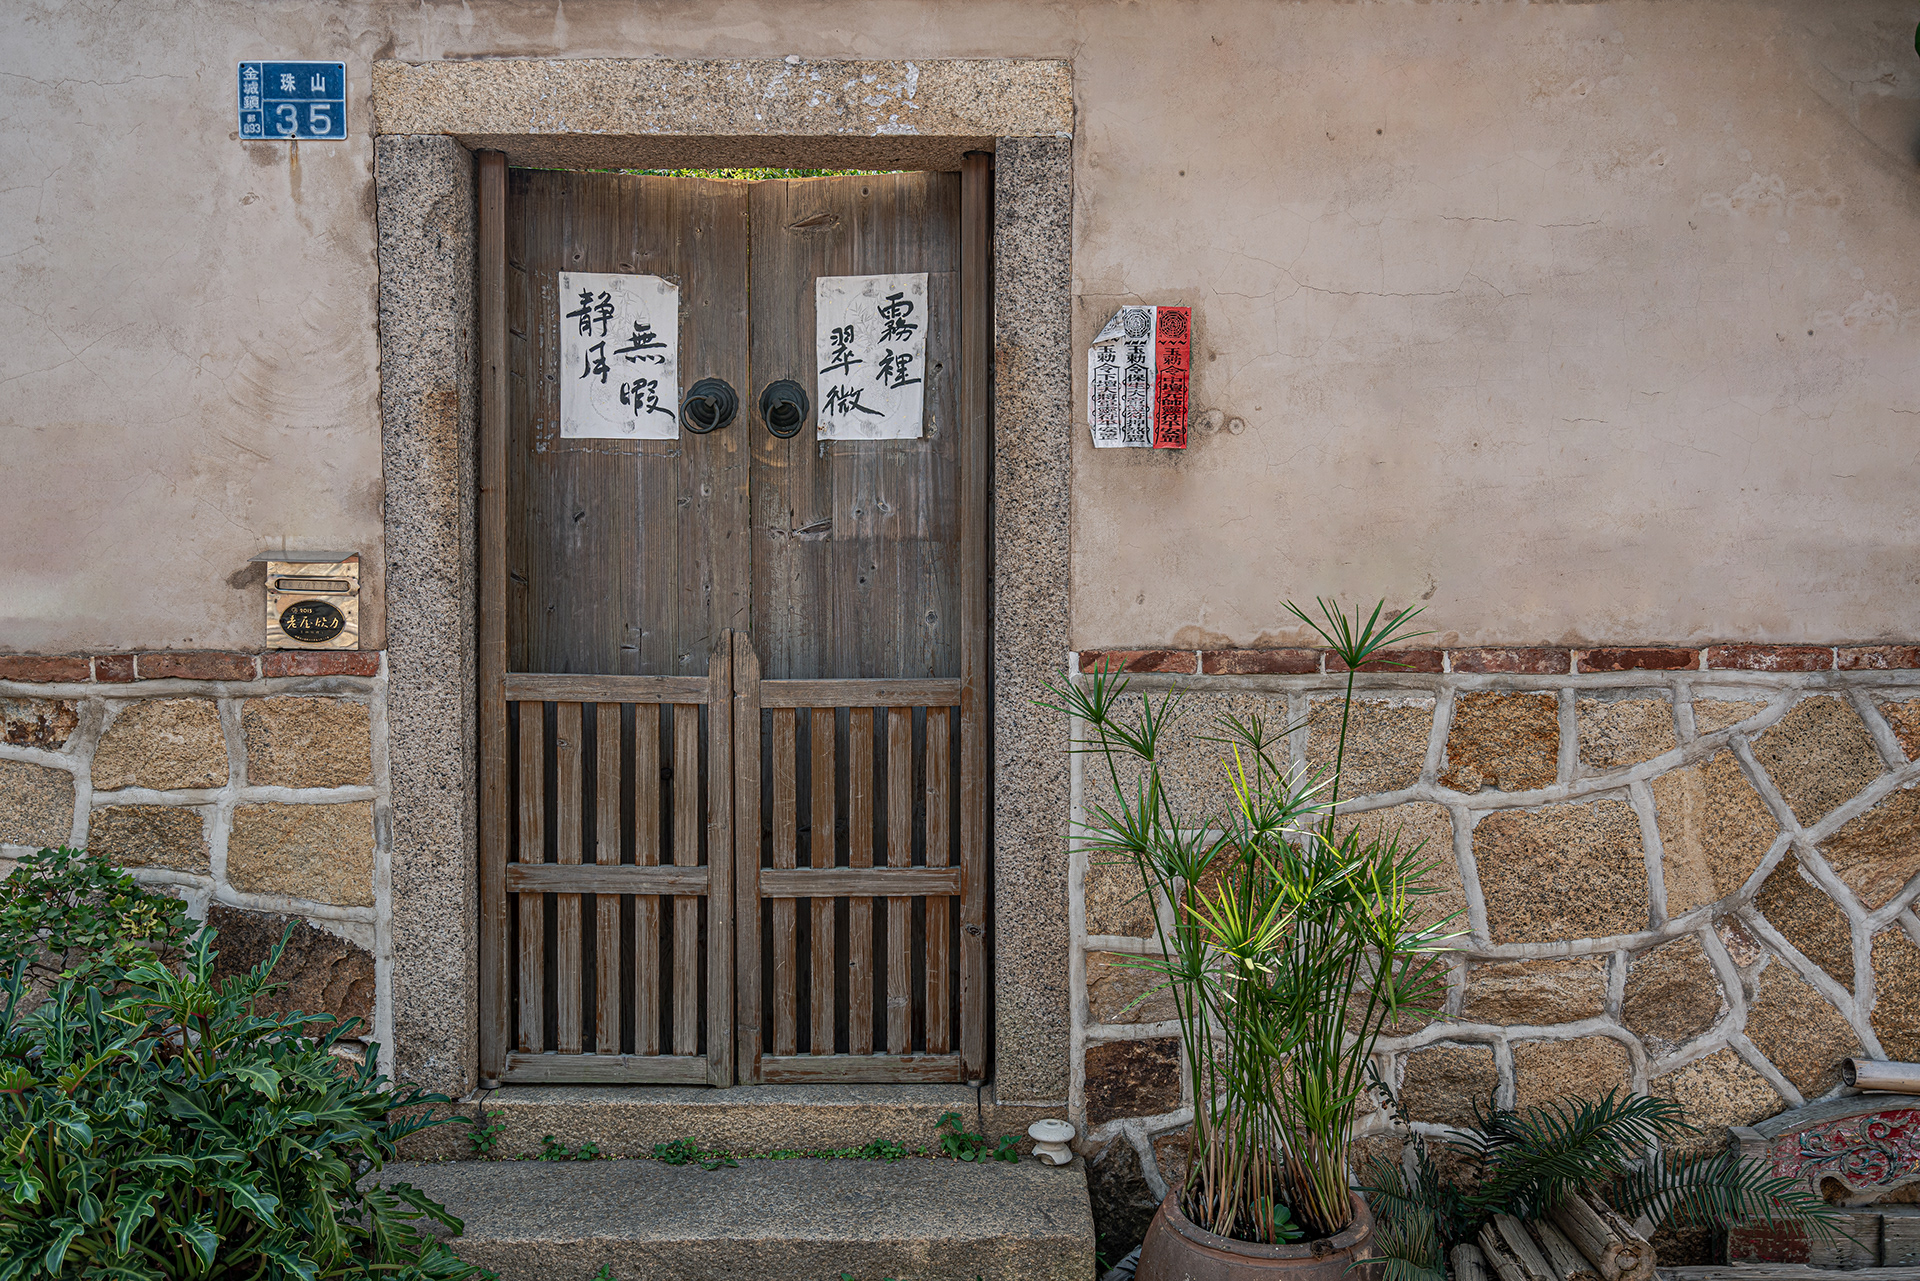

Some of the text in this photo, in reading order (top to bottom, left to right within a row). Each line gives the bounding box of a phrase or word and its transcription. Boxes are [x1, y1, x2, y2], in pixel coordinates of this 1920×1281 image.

[243, 67, 259, 109] 金城鎮
[280, 73, 325, 92] 珠山
[243, 123, 261, 133] 893
[276, 103, 331, 135] 35
[876, 291, 922, 389] 霧裡
[820, 325, 885, 417] 翠微
